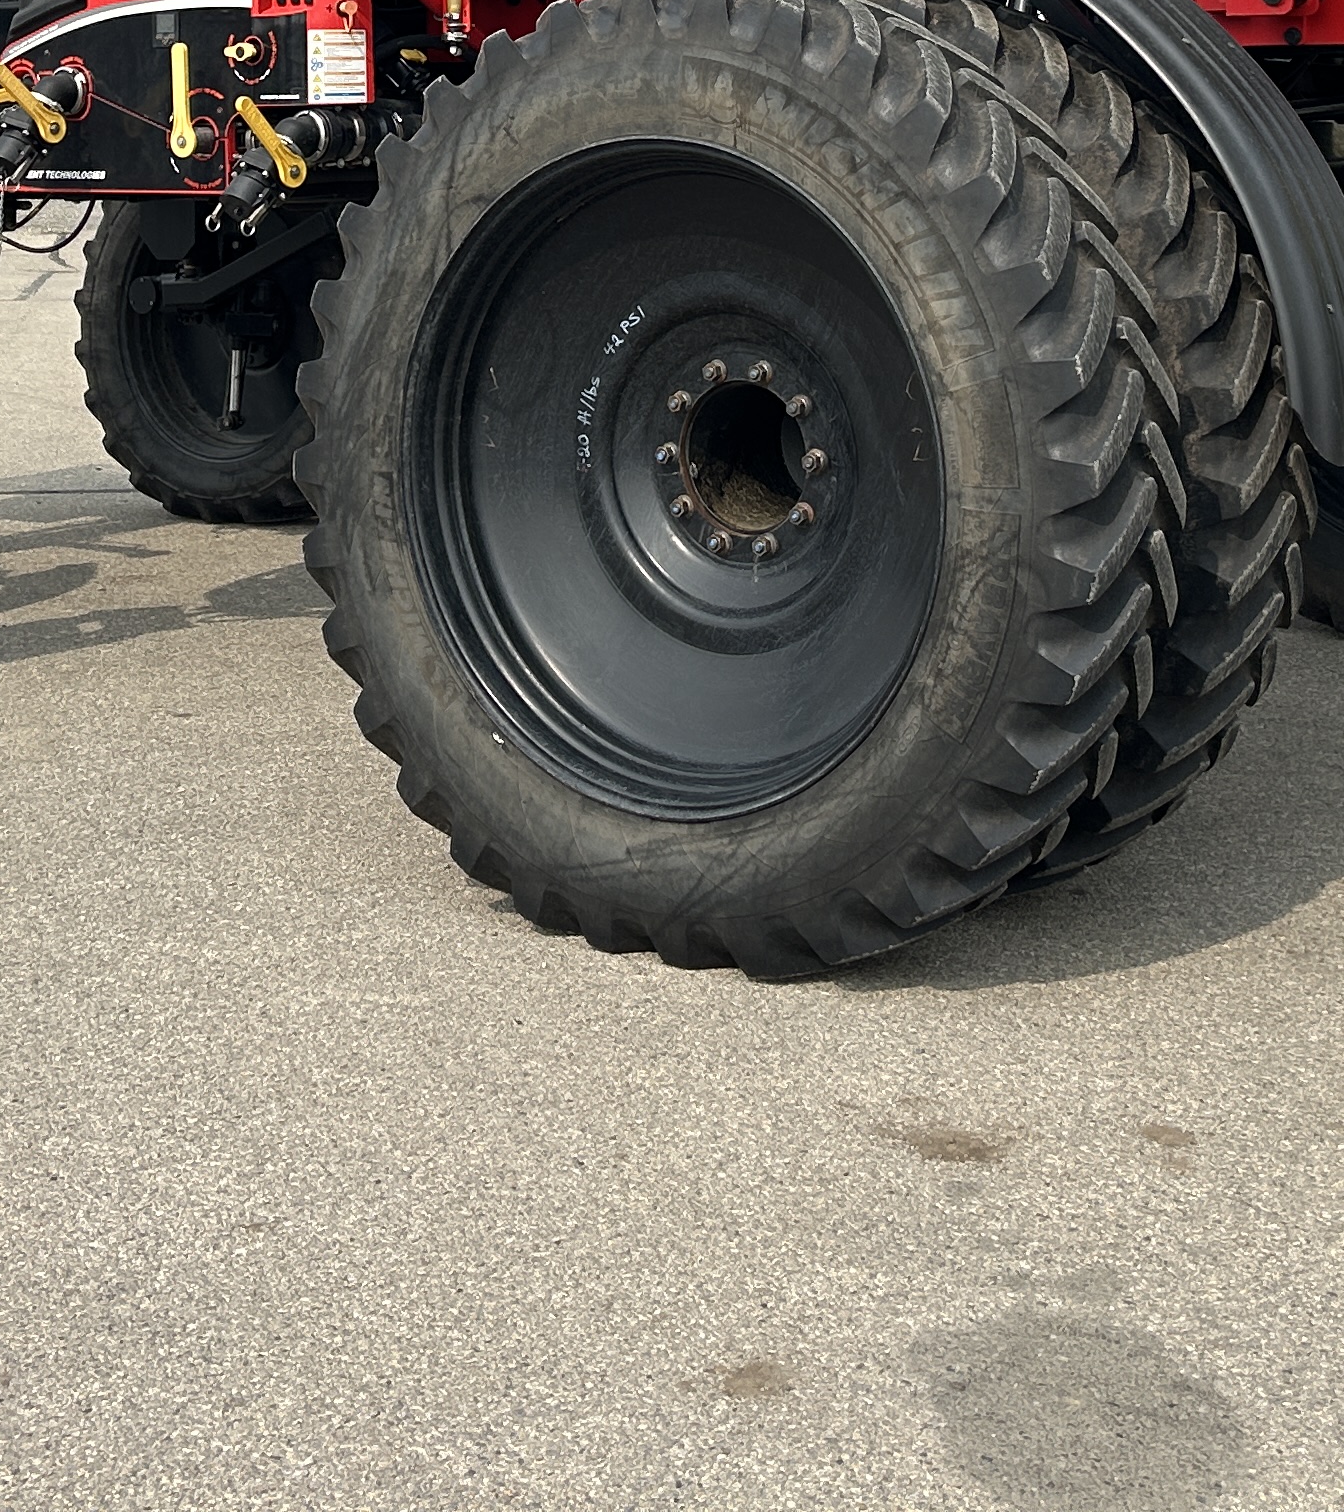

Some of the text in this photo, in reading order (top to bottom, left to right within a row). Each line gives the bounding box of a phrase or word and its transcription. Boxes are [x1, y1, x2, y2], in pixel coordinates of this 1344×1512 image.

[756, 85, 988, 352] MICHELIN
[603, 333, 624, 355] 42
[619, 305, 646, 335] PSI
